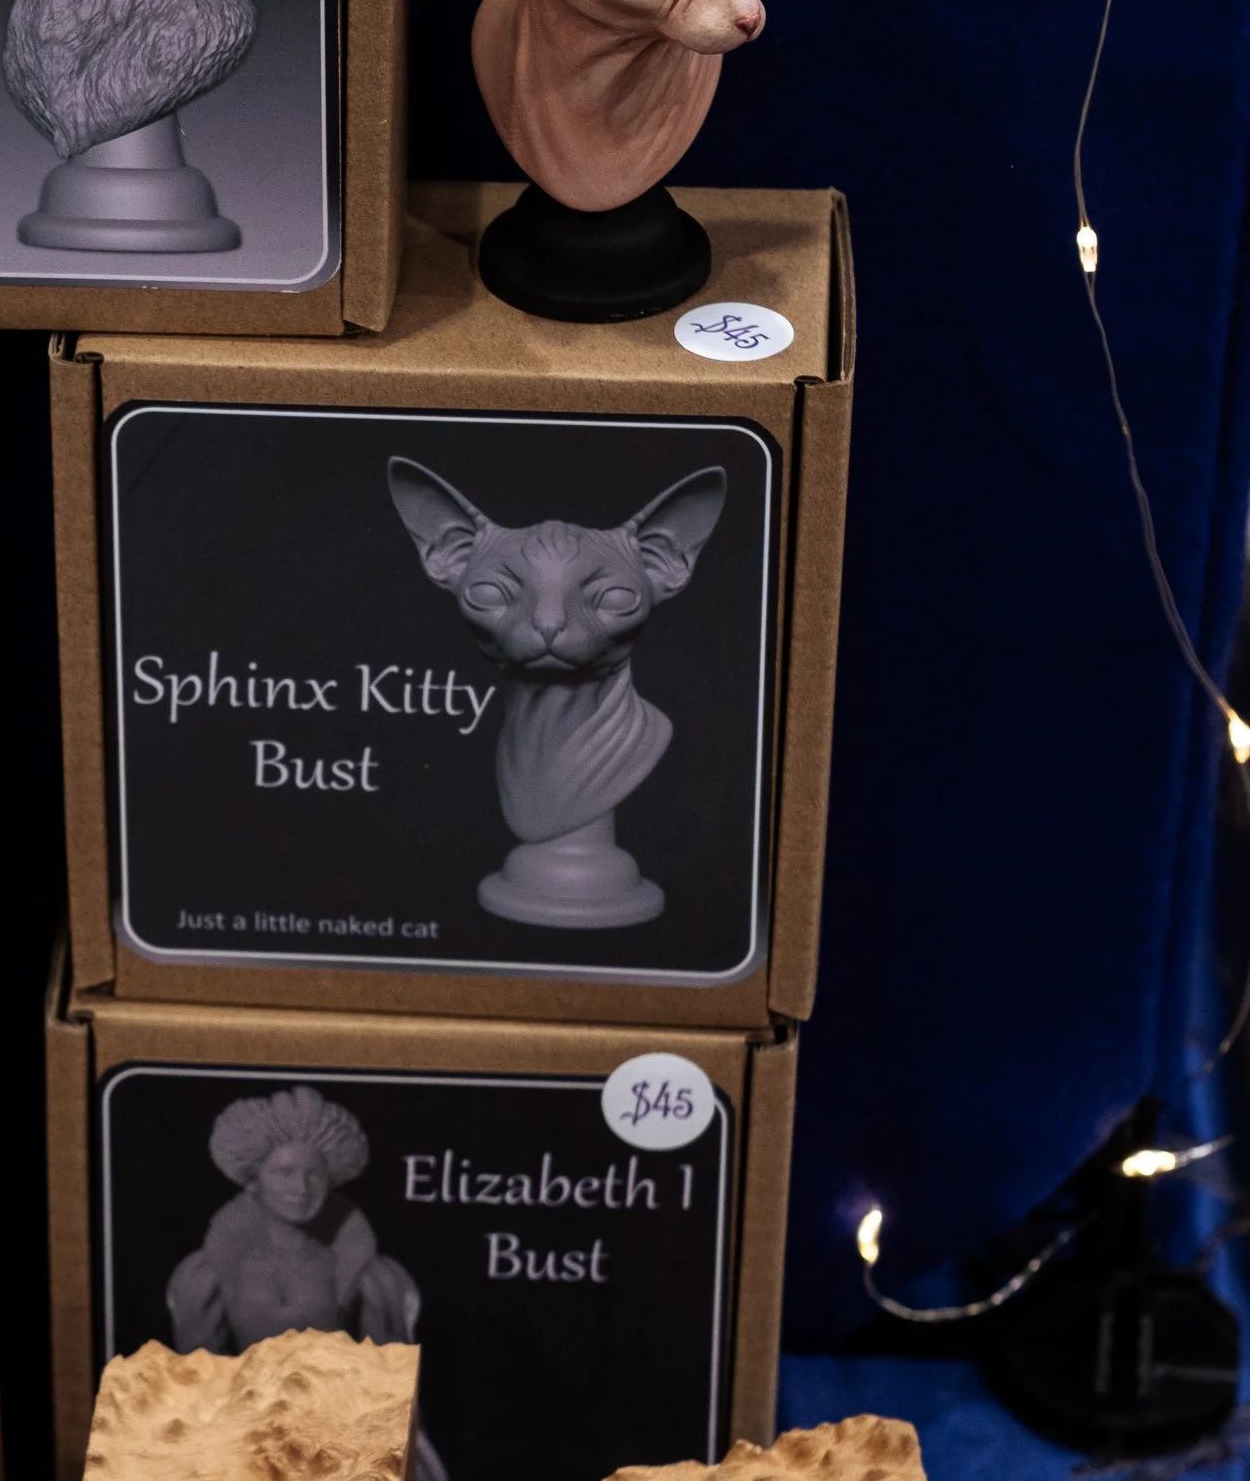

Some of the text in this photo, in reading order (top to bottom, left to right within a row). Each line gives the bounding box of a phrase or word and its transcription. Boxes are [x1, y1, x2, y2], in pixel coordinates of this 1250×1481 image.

[690, 315, 770, 349] $45
[133, 650, 496, 735] Sphinx Kitty
[249, 739, 380, 792] Bust
[177, 909, 440, 939] Just a little naked cat
[619, 1080, 693, 1127] $45
[403, 1148, 659, 1210] Elizabeth
[485, 1232, 610, 1284] Bust
